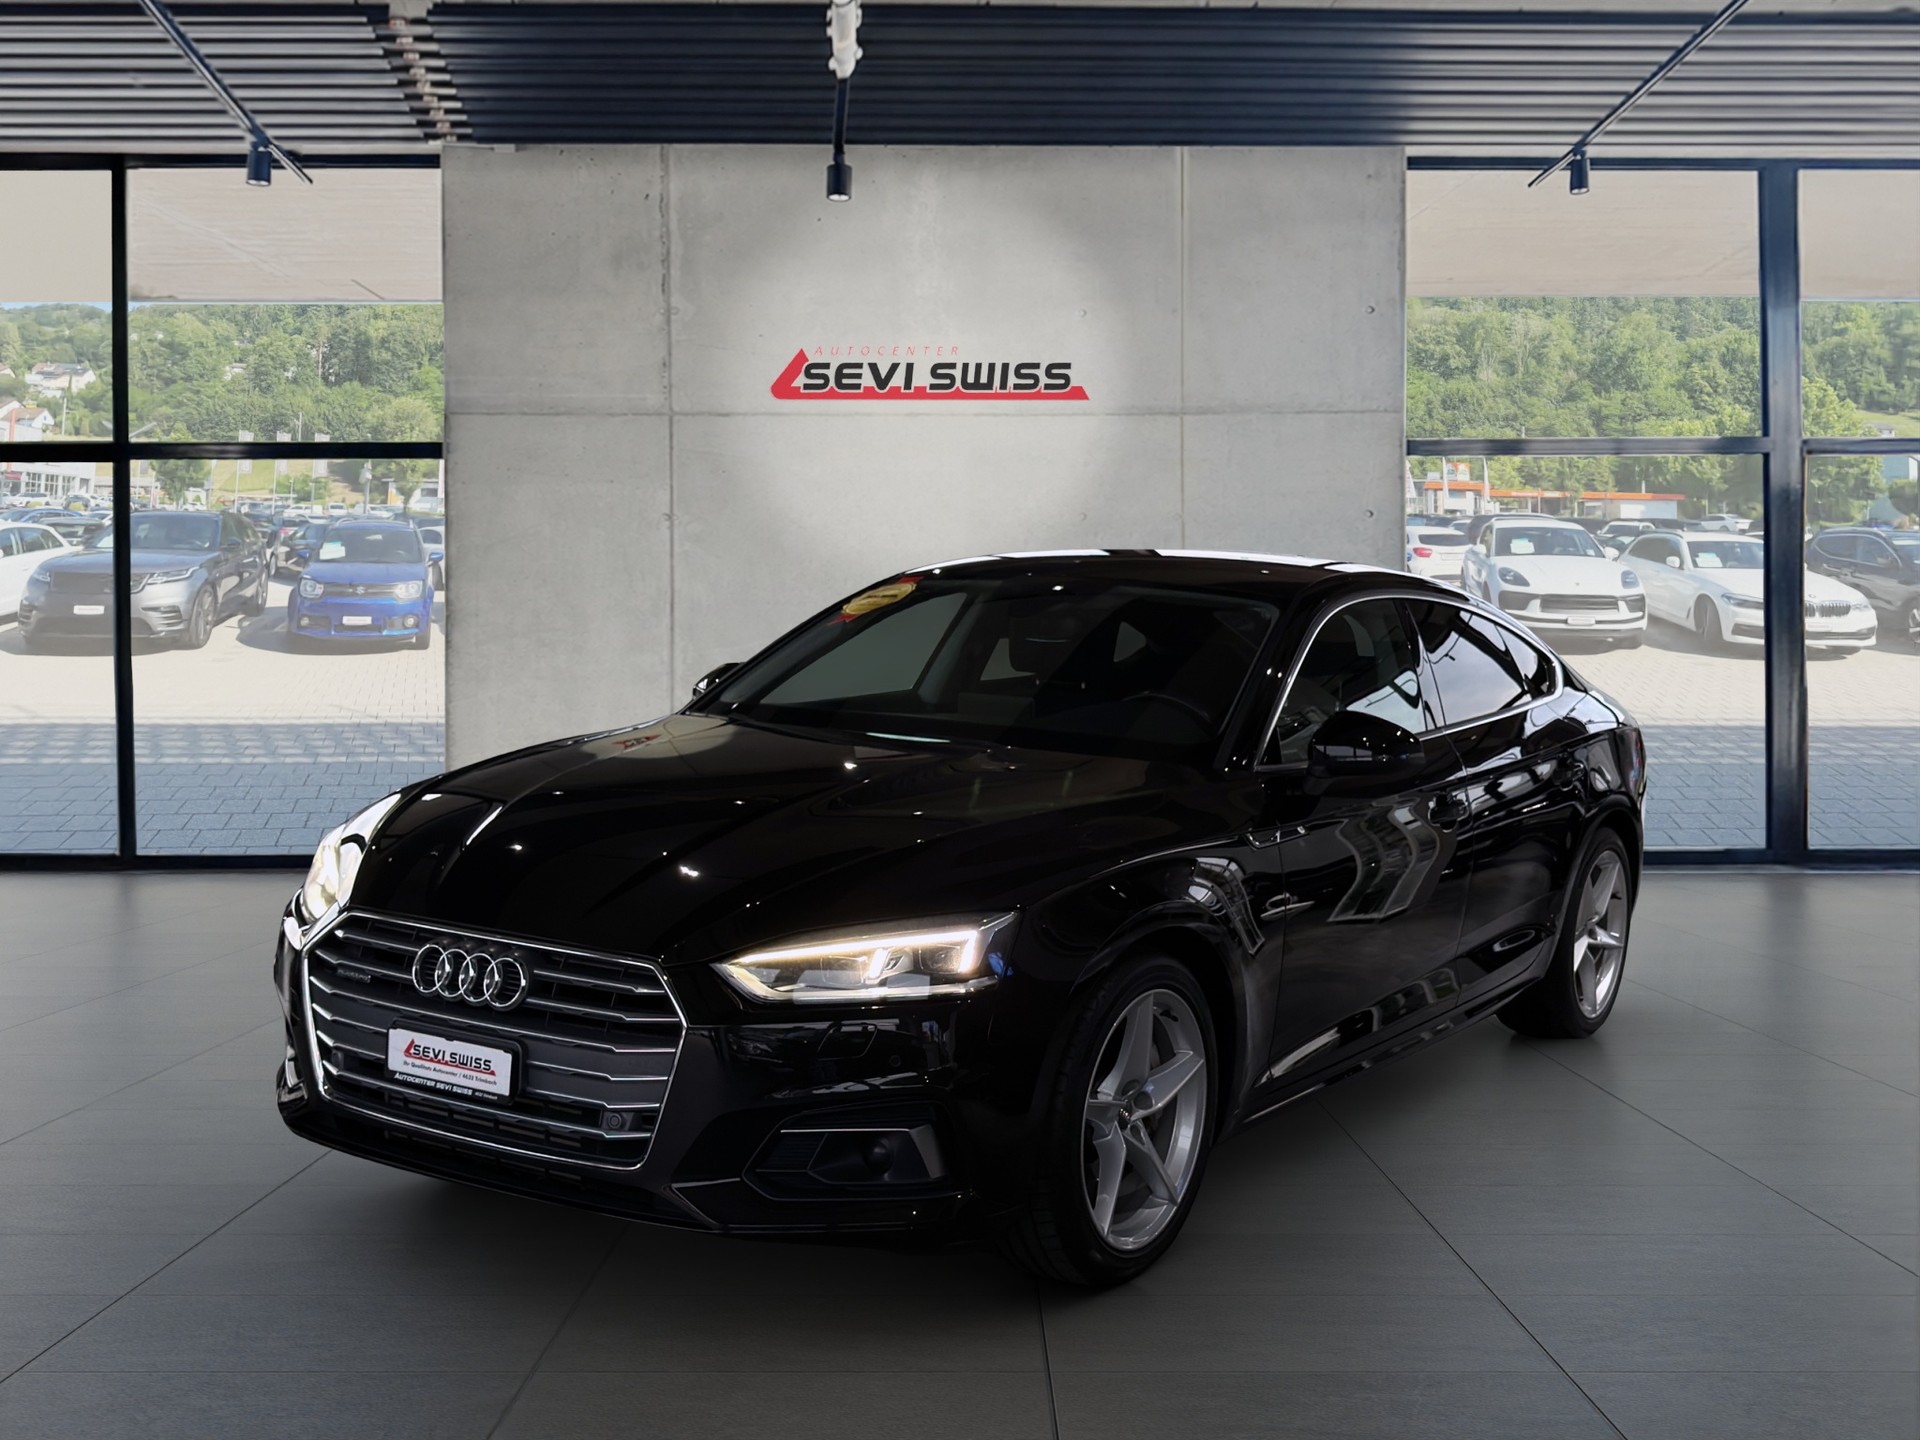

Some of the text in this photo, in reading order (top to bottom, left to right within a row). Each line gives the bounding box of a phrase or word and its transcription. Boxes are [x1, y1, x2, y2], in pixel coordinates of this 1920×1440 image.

[813, 346, 960, 356] AUTOCENTER
[802, 362, 1072, 391] SEVI SWISS
[413, 1044, 492, 1071] SEVI SWISS
[432, 1066, 458, 1077] Autocenter
[394, 1072, 436, 1087] AUTOCENTER
[436, 1081, 452, 1091] SEVI
